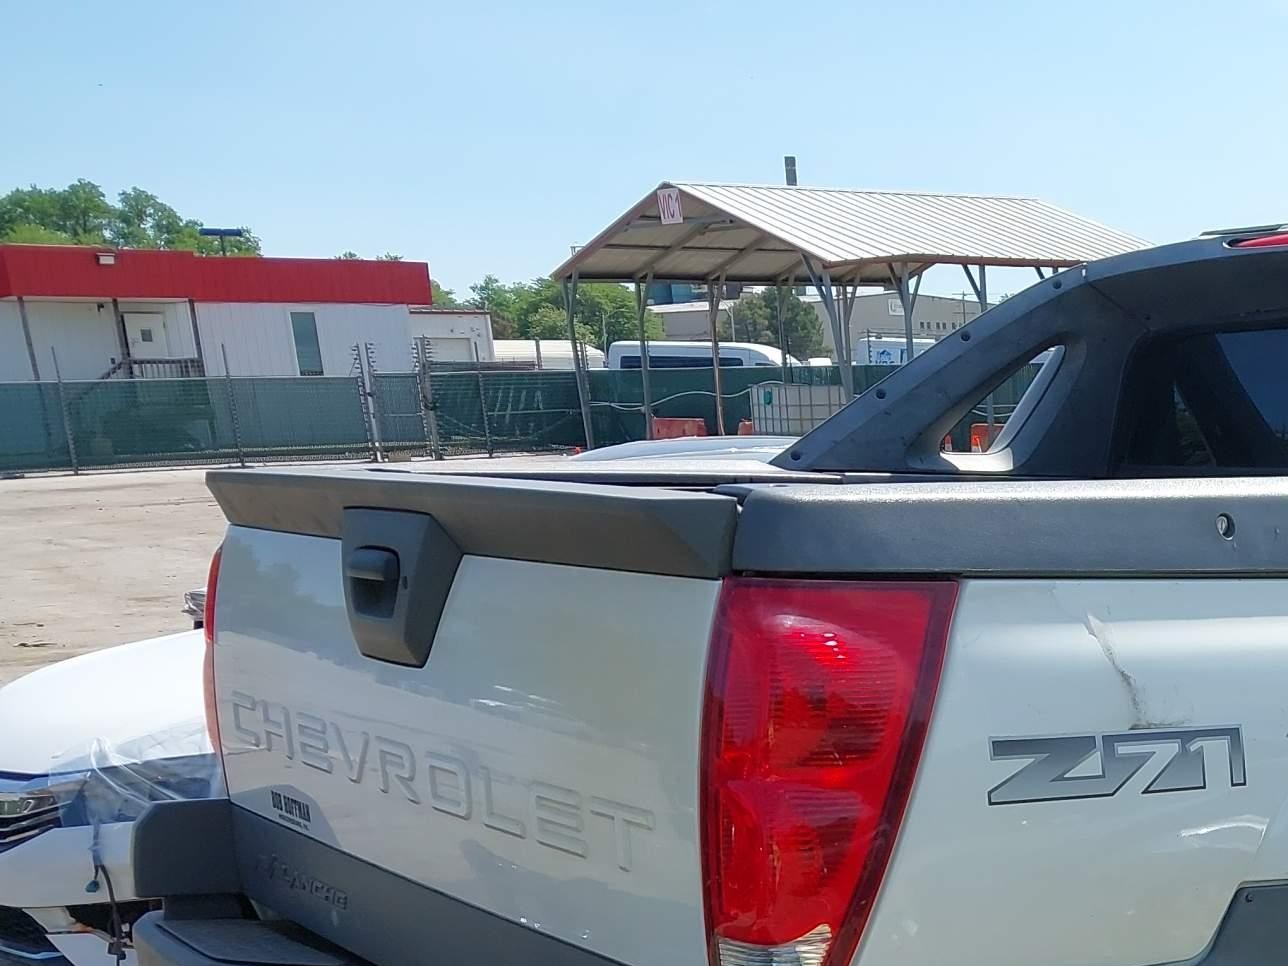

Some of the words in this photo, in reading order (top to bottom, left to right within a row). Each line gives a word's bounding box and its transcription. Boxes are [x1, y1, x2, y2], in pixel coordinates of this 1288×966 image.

[658, 193, 675, 219] VIC
[231, 690, 656, 872] CHEVROLET
[988, 724, 1247, 806] Z71
